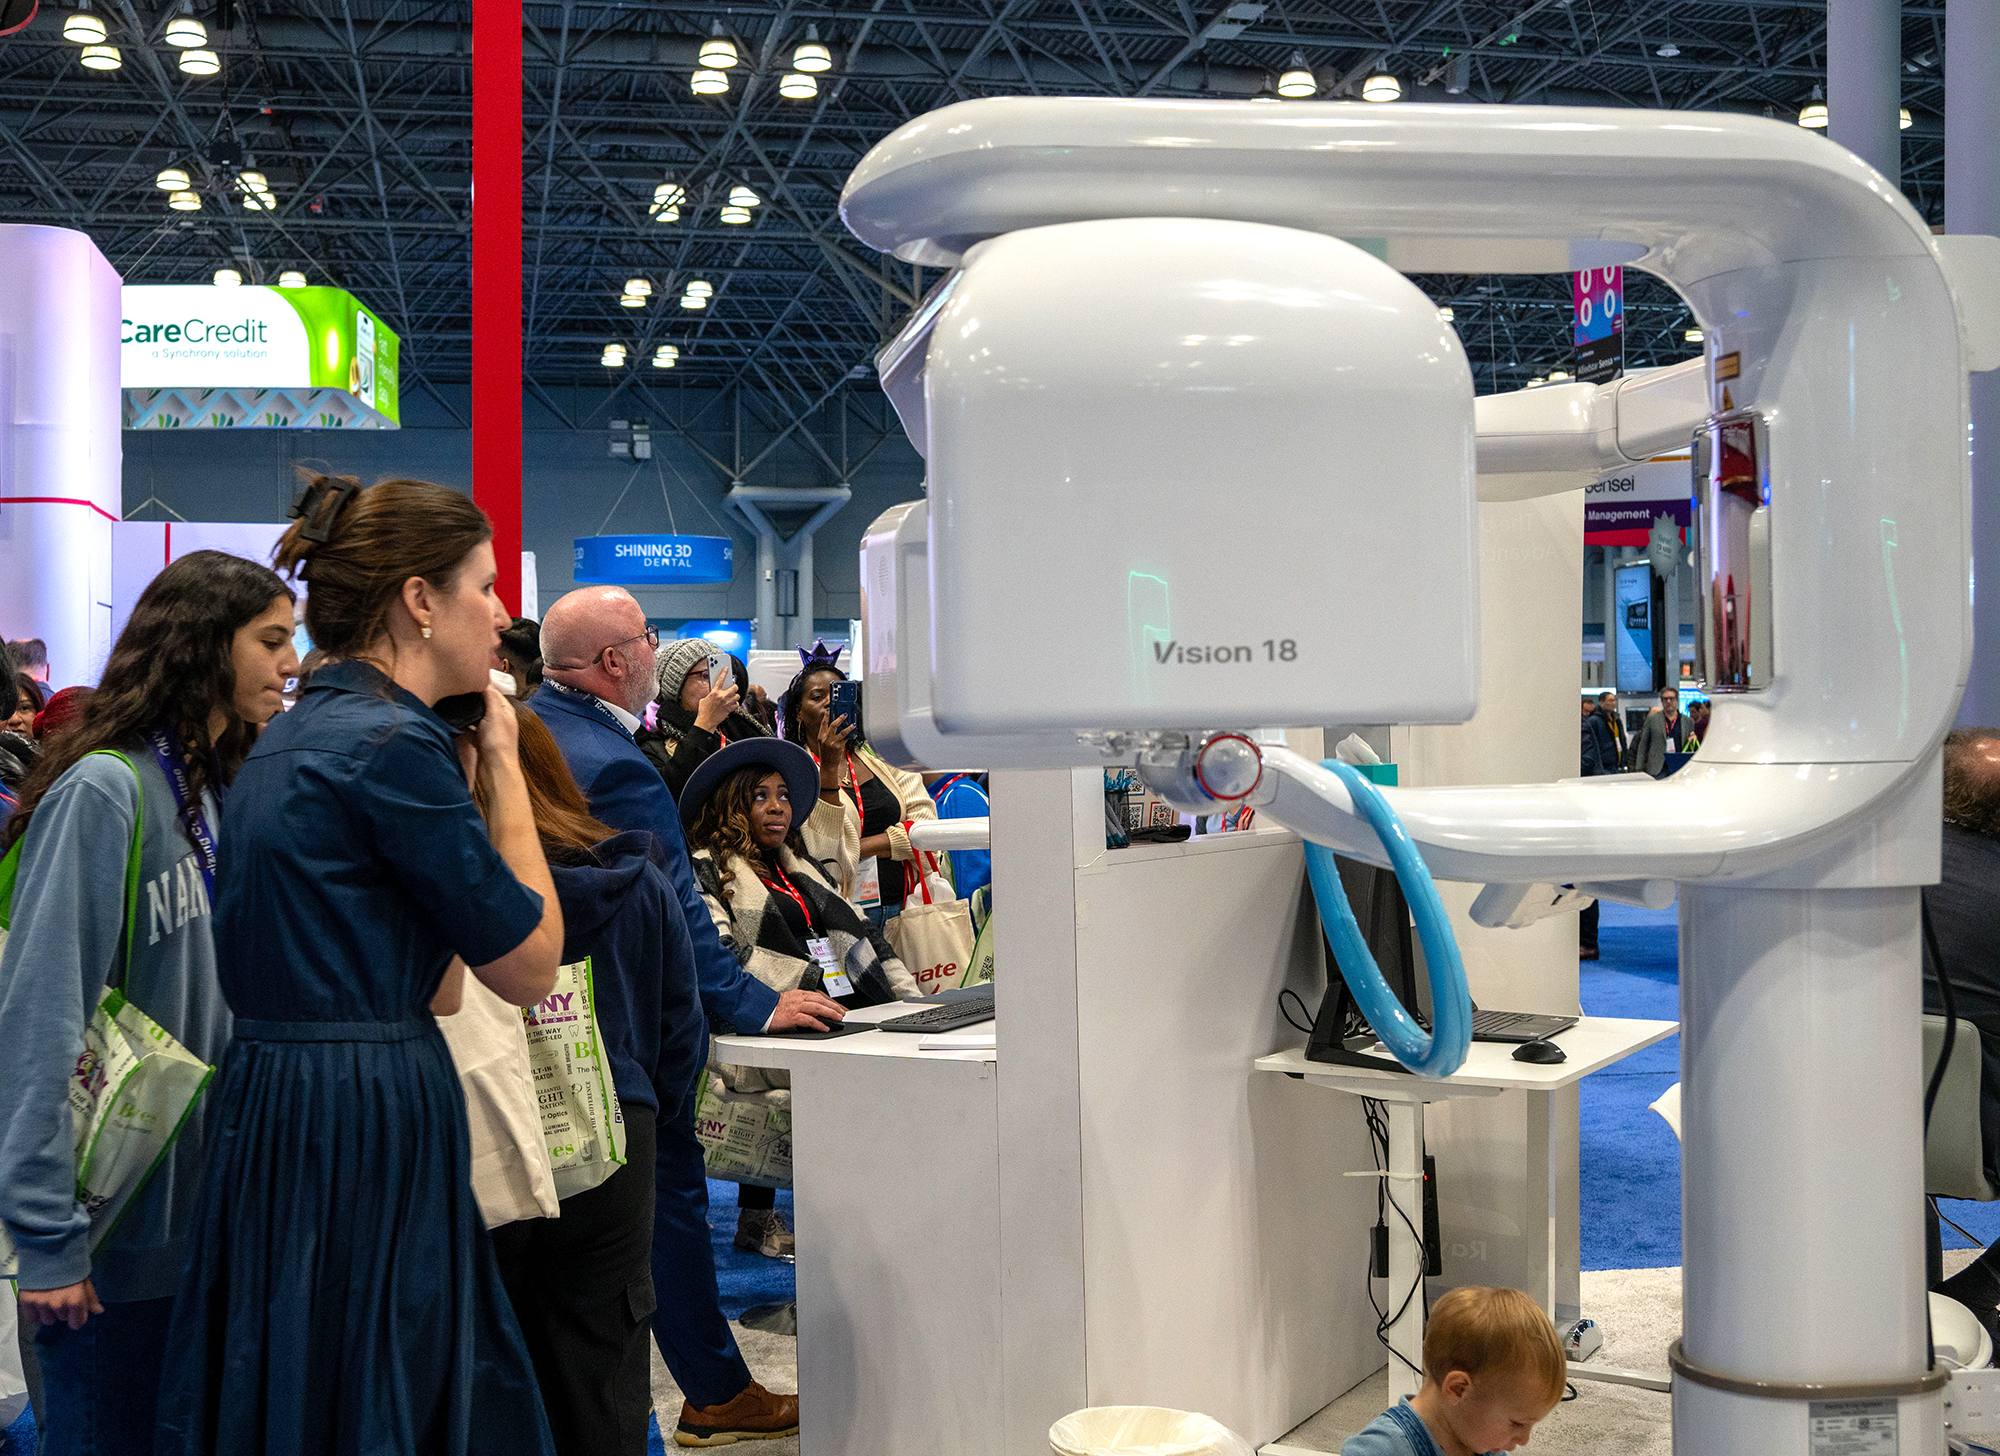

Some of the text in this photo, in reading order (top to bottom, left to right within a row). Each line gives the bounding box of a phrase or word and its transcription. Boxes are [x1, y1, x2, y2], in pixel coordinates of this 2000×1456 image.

[121, 318, 267, 343] CareCredit
[152, 348, 267, 360] a Synchrony solution
[1588, 508, 1650, 522] Management
[615, 544, 692, 558] SHINING 3D
[643, 557, 692, 569] DENTAL
[1153, 639, 1297, 664] Vision 18
[545, 1027, 562, 1035] WAY
[531, 1034, 563, 1045] DIRECT-LED
[577, 1065, 590, 1074] The
[538, 1091, 565, 1104] GHT
[547, 1110, 569, 1119] Optics
